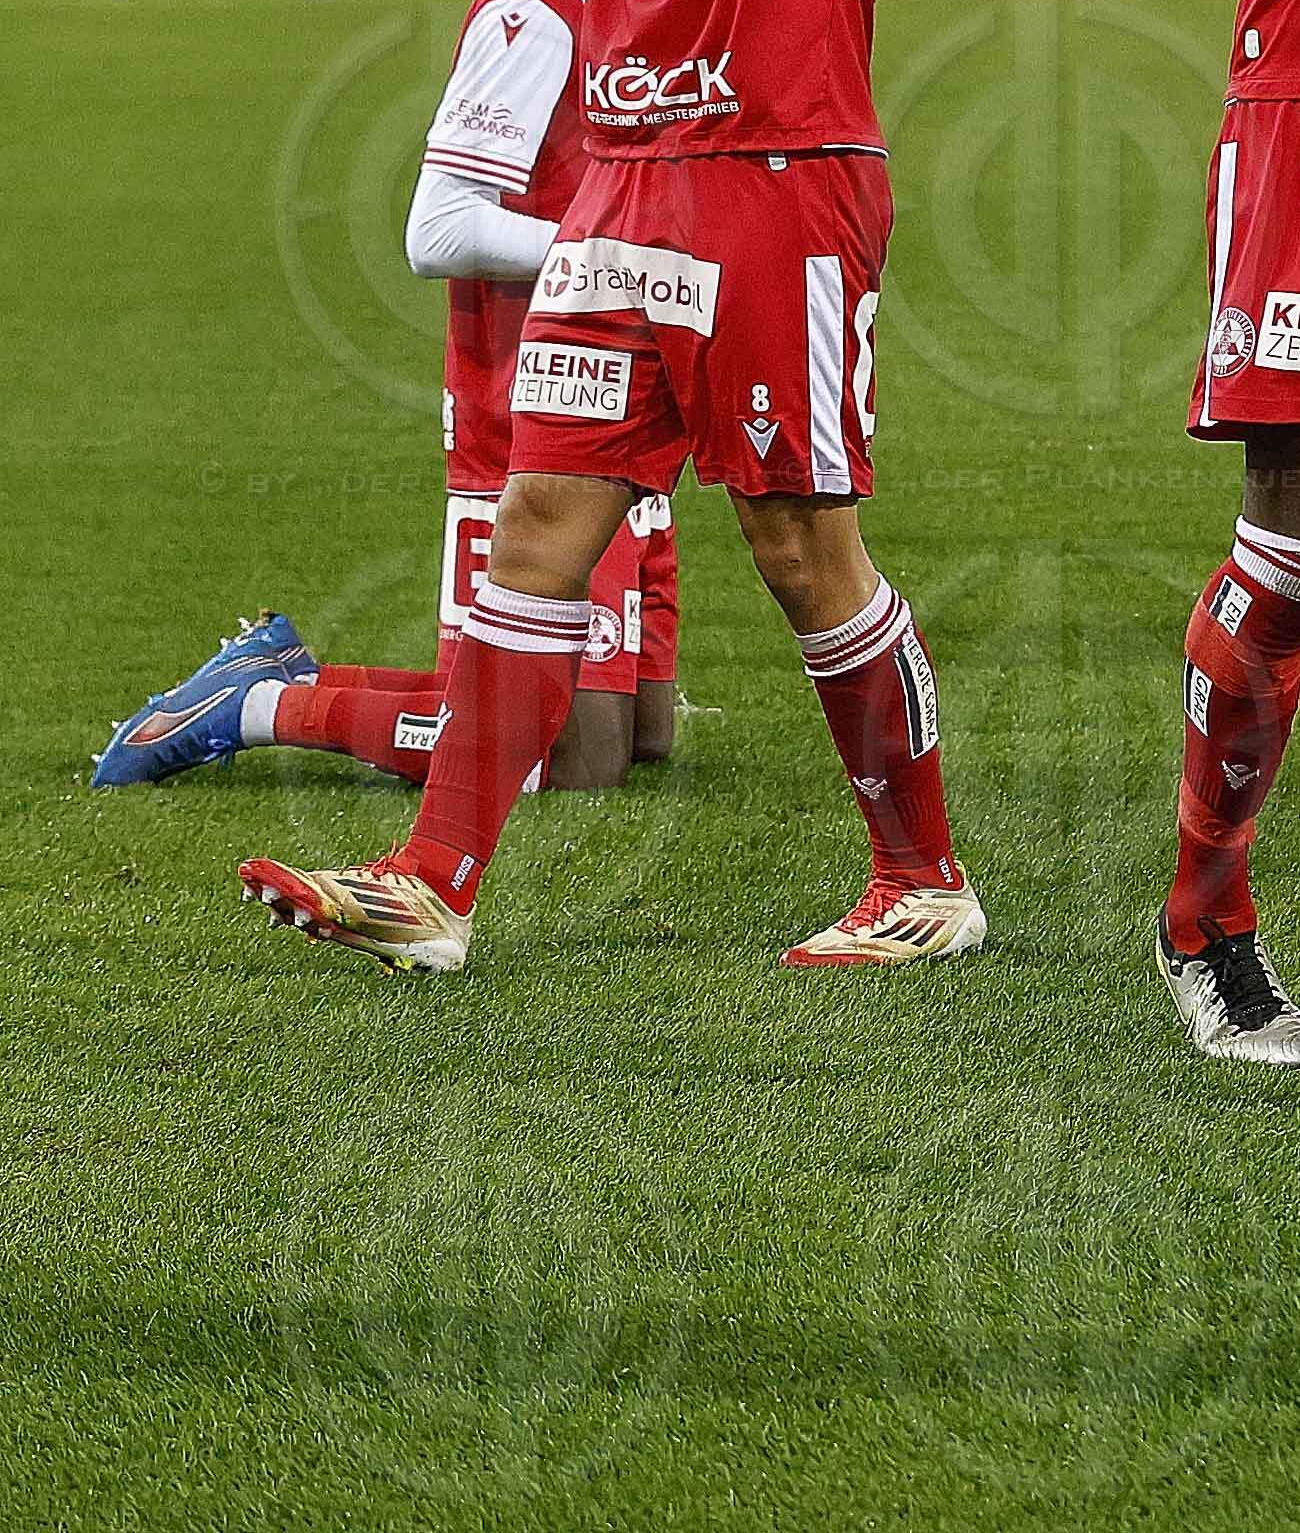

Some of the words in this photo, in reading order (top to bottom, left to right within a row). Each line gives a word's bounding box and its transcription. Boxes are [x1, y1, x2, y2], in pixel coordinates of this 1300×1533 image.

[585, 51, 737, 108] KÖCK
[519, 351, 622, 384] KLEINE
[516, 378, 619, 412] ZEITUNG
[751, 384, 770, 412] 8
